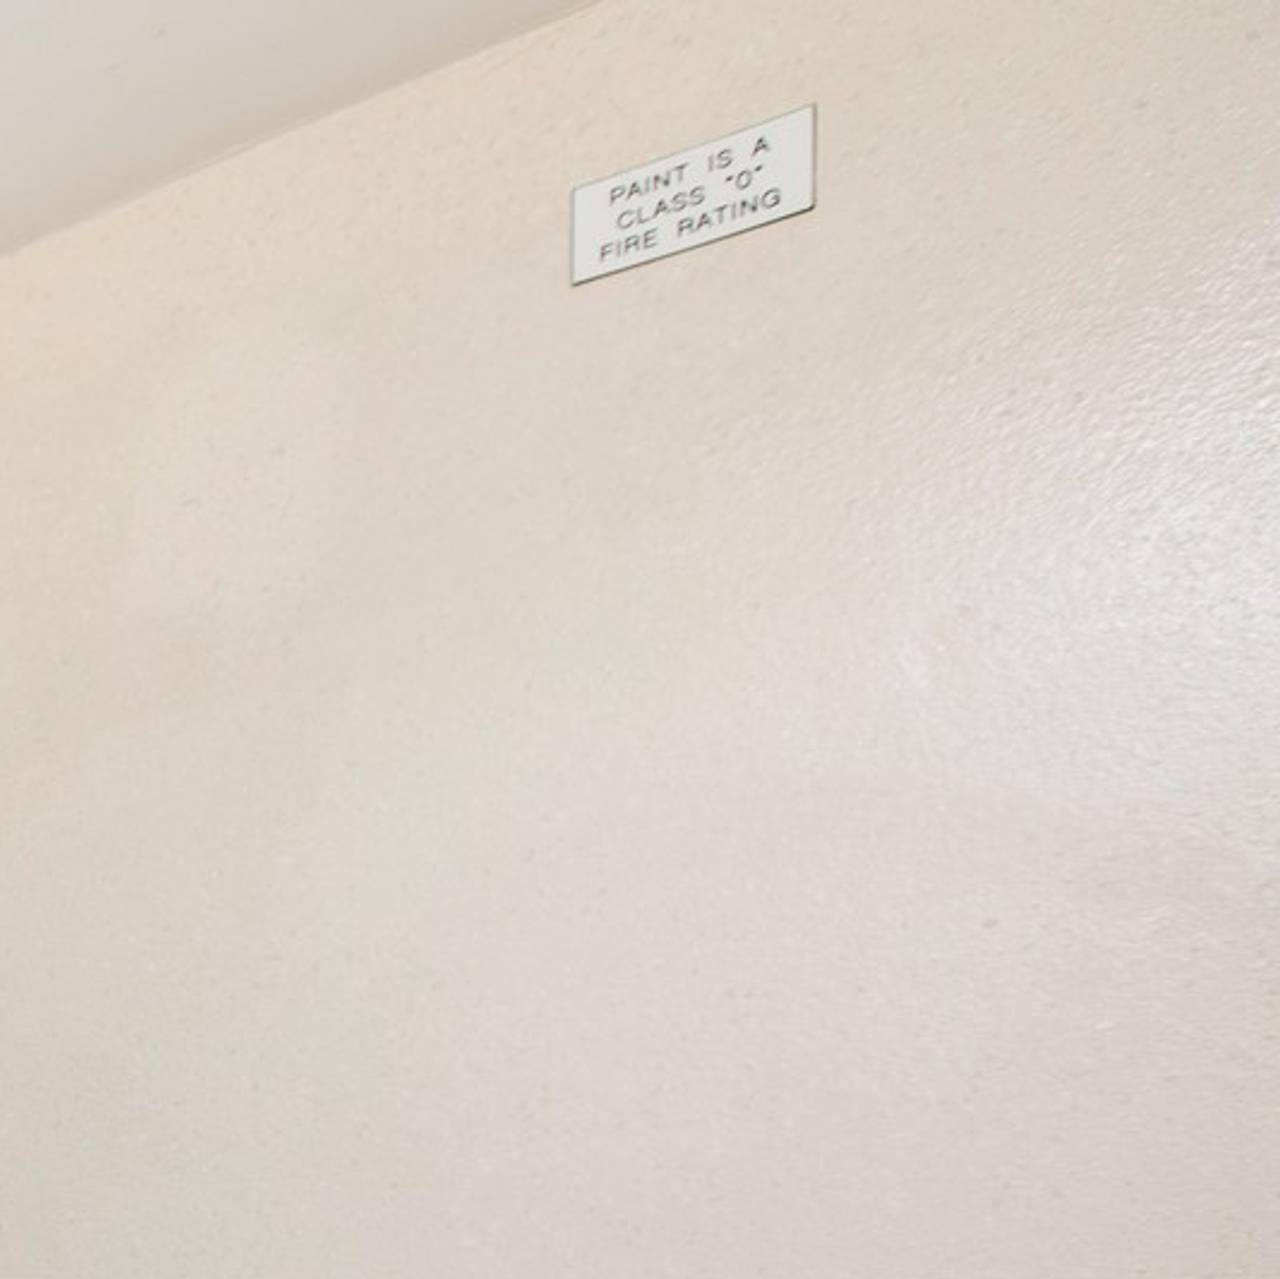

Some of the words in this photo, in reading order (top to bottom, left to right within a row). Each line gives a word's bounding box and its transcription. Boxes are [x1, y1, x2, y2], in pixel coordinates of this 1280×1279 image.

[608, 162, 689, 206] PAINT
[707, 148, 734, 172] IS
[751, 136, 771, 157] A
[599, 227, 658, 262] FIRE
[676, 187, 782, 238] RATING
[615, 185, 706, 230] CLASS
